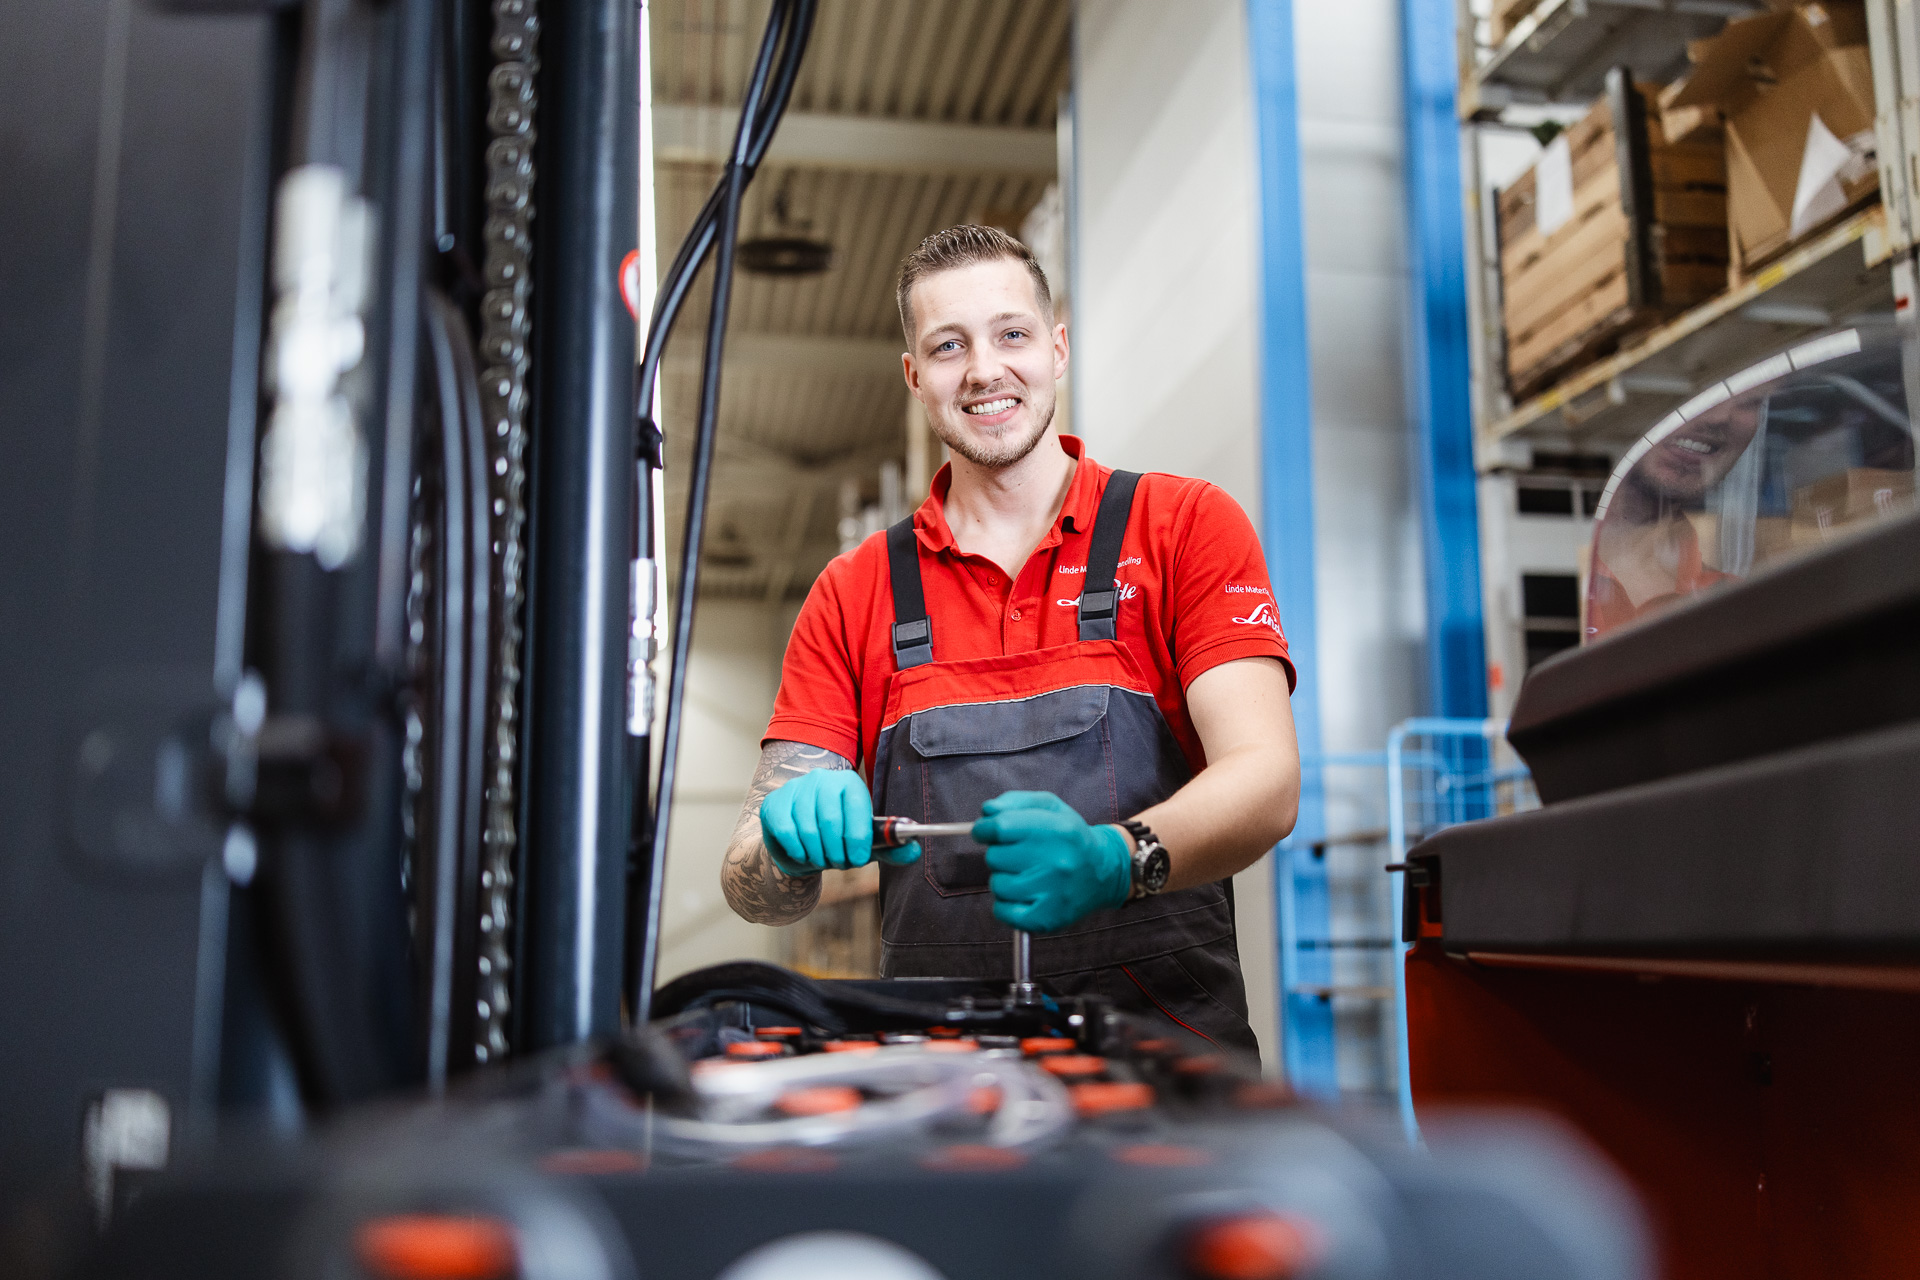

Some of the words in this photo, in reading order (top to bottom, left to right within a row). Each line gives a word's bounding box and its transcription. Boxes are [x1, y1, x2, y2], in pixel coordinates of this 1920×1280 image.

[1058, 564, 1079, 574] Linde
[1117, 556, 1142, 569] andling
[1225, 584, 1245, 593] Linde
